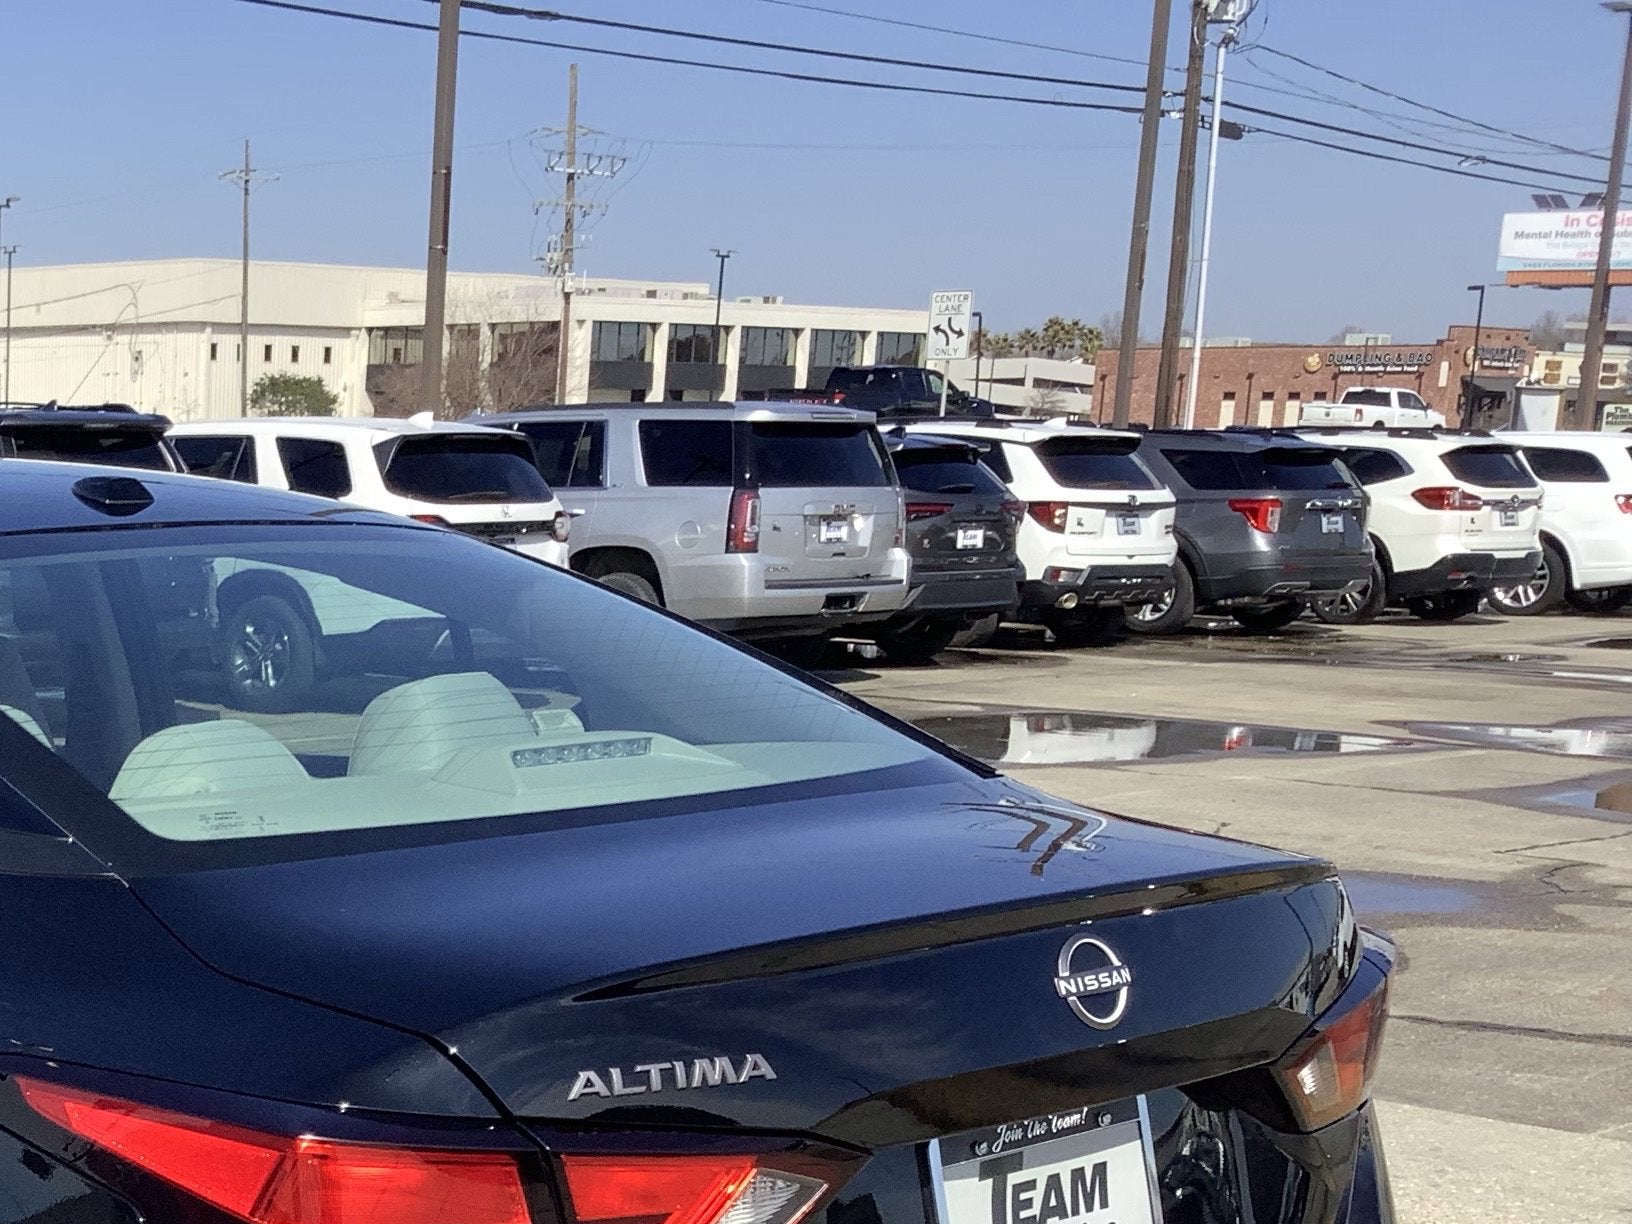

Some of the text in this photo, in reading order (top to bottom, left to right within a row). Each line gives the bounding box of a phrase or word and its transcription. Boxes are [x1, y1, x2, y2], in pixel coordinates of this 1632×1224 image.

[1564, 214, 1580, 227] In
[1514, 230, 1553, 240] Mental
[1554, 229, 1591, 239] Health
[934, 294, 969, 303] CENTER
[938, 303, 963, 313] LANE
[934, 347, 960, 356] ONLY
[1327, 352, 1433, 363] DUMPLING & BAO
[1059, 967, 1132, 995] NISSAN
[567, 1053, 778, 1101] ALTIMA
[992, 1124, 1023, 1153] Join
